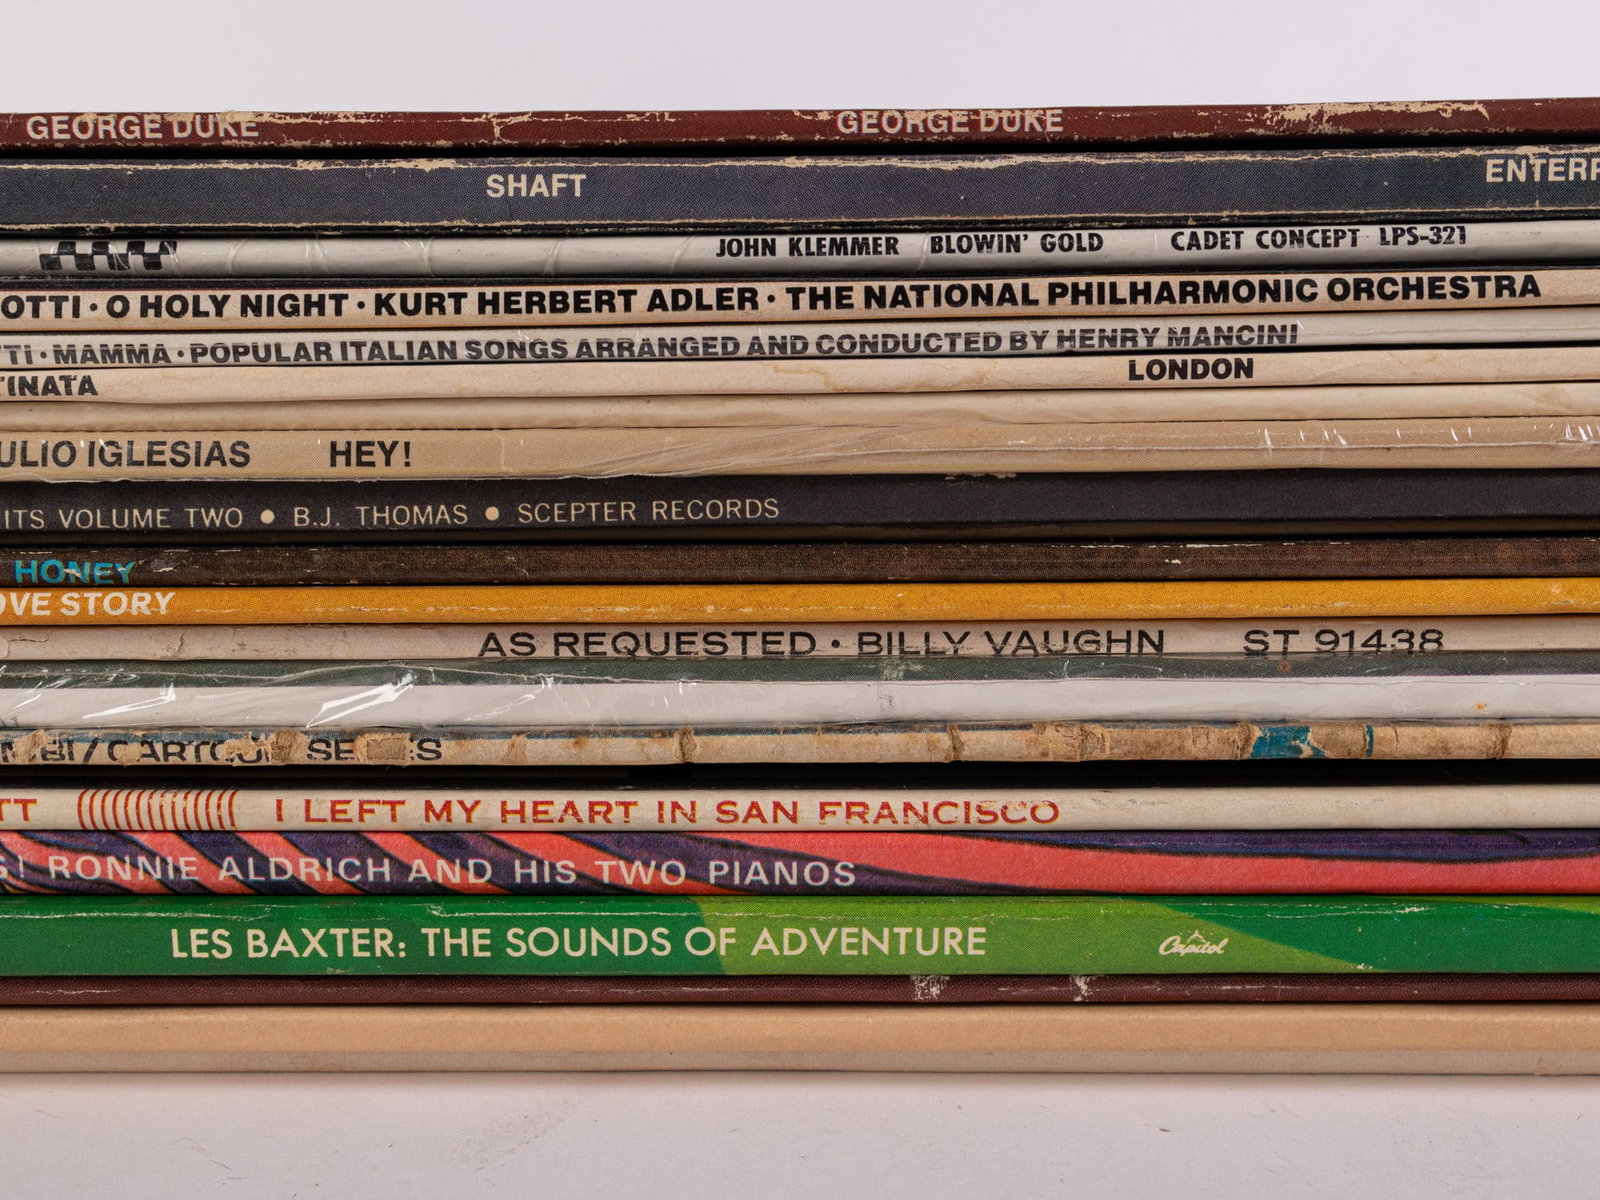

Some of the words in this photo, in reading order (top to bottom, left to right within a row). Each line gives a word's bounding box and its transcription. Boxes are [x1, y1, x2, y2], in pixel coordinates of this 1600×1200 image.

[27, 115, 163, 139] GEORGE
[173, 114, 259, 138] DUKE
[837, 110, 969, 134] GEORGE
[979, 109, 1064, 132] DUKE
[486, 173, 586, 198] SHAFT
[716, 237, 776, 257] JOHN
[789, 236, 899, 256] KLEMMER
[930, 235, 1028, 255] BLOWIN'
[1041, 233, 1104, 253] GOLD
[1171, 231, 1242, 251] CADET
[1256, 228, 1359, 249] CONCEPT
[1379, 226, 1466, 247] LPS-321
[0, 295, 80, 319] OTTI
[106, 295, 130, 319] O
[140, 294, 231, 318] HOLY
[241, 293, 348, 317] NIGHT
[375, 292, 467, 316] KURT
[478, 290, 637, 315] HERBERT
[647, 287, 759, 313] ADLER
[786, 286, 854, 311] THE
[864, 283, 1039, 309] NATIONAL
[1048, 279, 1318, 306] PHILHARMONIC
[1327, 275, 1540, 302] ORCHESTRA
[52, 343, 171, 365] MAMMA
[191, 341, 333, 364] POPULAR
[340, 340, 457, 362] ITALIAN
[465, 339, 569, 360] SONGS
[576, 336, 739, 360] ARRANGED
[747, 334, 809, 356] AND
[815, 331, 1000, 355] CONDUCTED
[1010, 330, 1050, 351] BY
[1056, 327, 1160, 350] HENRY
[1167, 323, 1298, 347] MANCINI
[1129, 358, 1253, 381] LONDON
[88, 439, 250, 468] IGLESIAS
[329, 440, 411, 468] HEY!
[4, 509, 45, 530] ITS
[58, 508, 171, 529] VOLUME
[184, 507, 243, 529] TWO
[293, 506, 340, 527] B.J.
[355, 505, 468, 526] THOMAS
[518, 502, 635, 523] SCEPTER
[652, 499, 779, 521] RECORDS
[15, 559, 136, 584] HONEY
[60, 592, 175, 616] STORY
[477, 632, 536, 658] AS
[553, 631, 817, 658] REQUESTED
[857, 631, 971, 656] BILLY
[986, 629, 1164, 656] VAUGHN
[1243, 629, 1299, 655] ST
[1314, 628, 1445, 653] 91438
[275, 799, 284, 822] I
[304, 798, 405, 823] LEFT
[424, 800, 480, 823] MY
[501, 800, 638, 825] HEART
[657, 800, 696, 824] IN
[715, 801, 798, 825] SAN
[819, 801, 1060, 826] FRANCISCO
[48, 855, 199, 881] RONNIE
[218, 856, 392, 883] ALDRICH
[408, 857, 493, 884] AND
[514, 858, 577, 885] HIS
[595, 860, 686, 886] TWO
[709, 860, 856, 887] PIANOS
[170, 928, 232, 959] LES
[248, 928, 406, 958] BAXTER:
[421, 928, 491, 957] THE
[506, 927, 671, 957] SOUNDS
[685, 926, 736, 956] OF
[751, 926, 987, 956] ADVENTURE
[1159, 931, 1229, 956] Capitol
